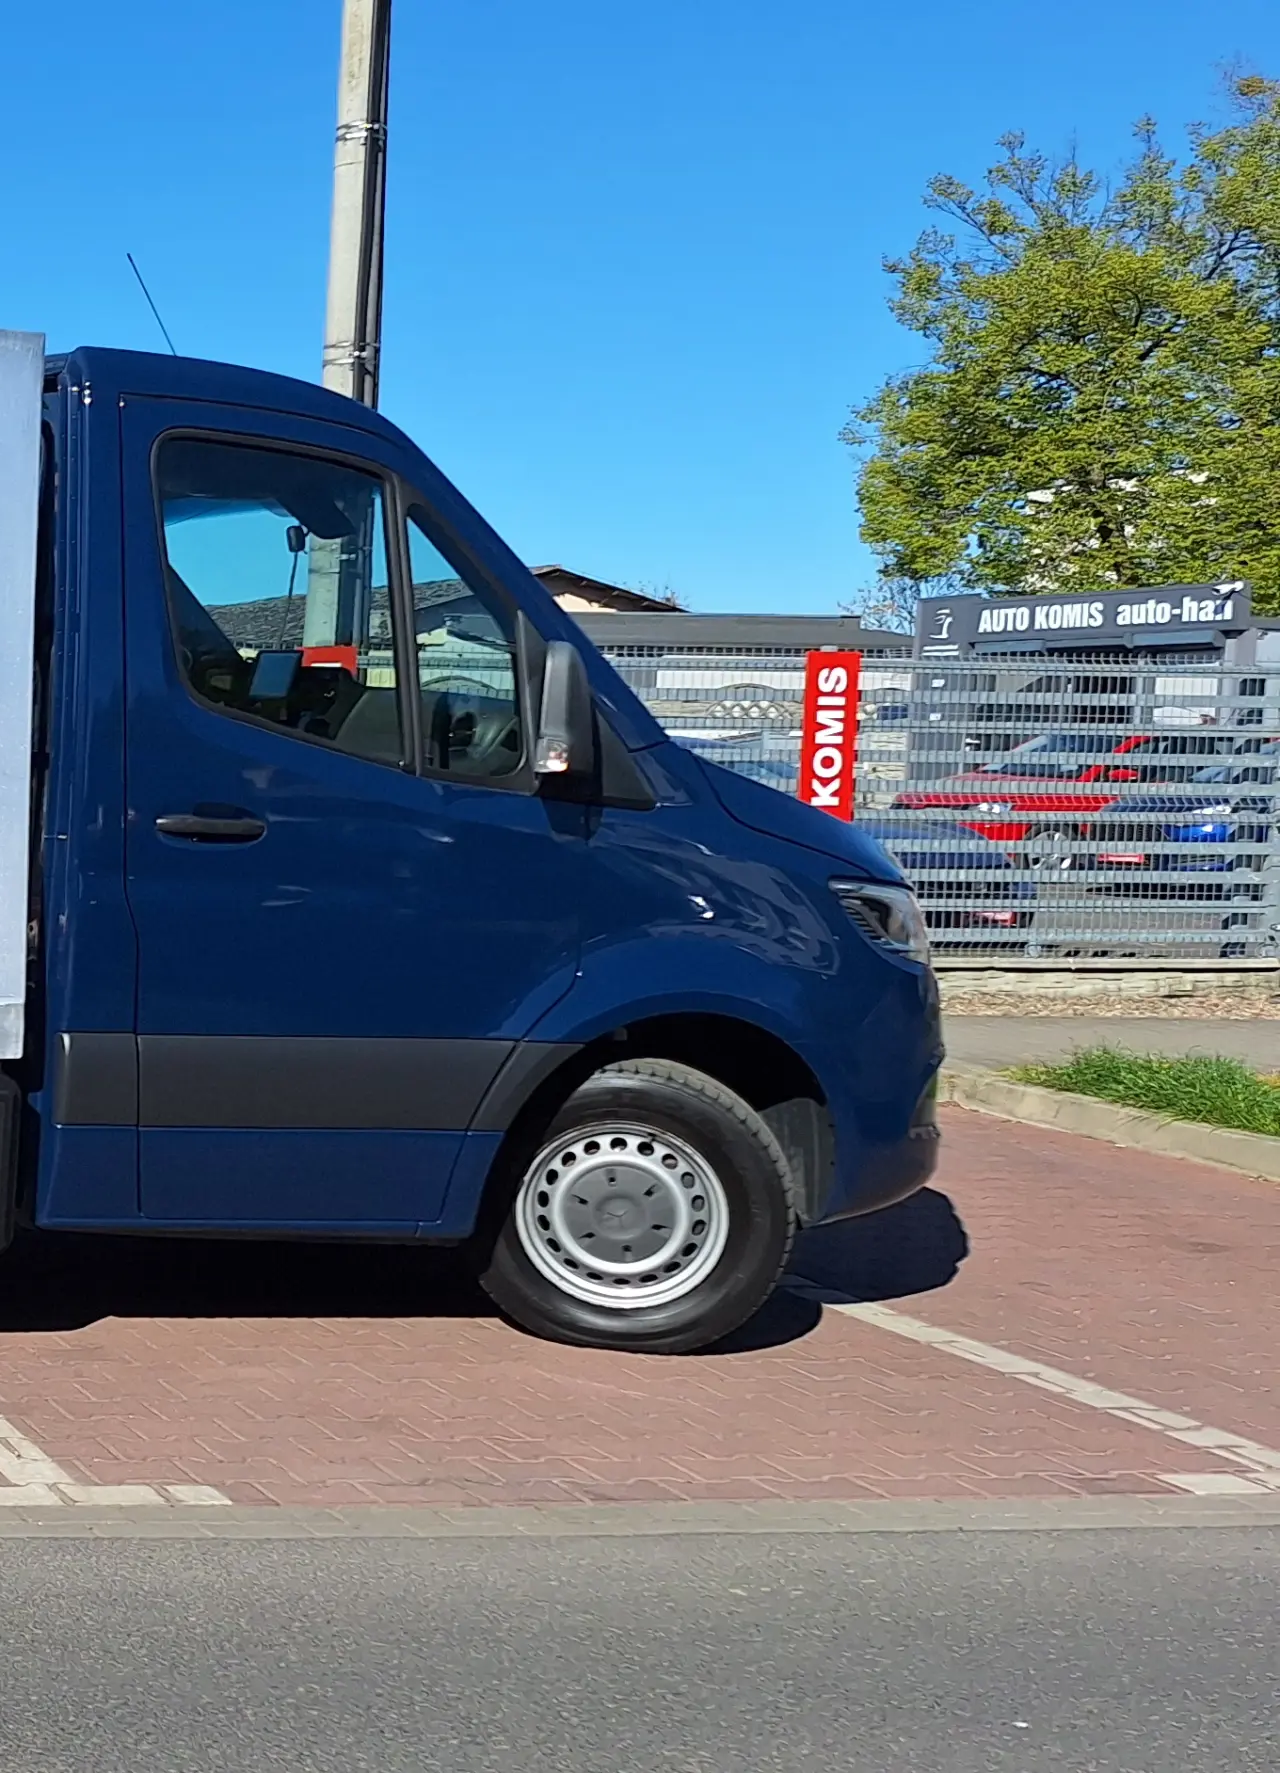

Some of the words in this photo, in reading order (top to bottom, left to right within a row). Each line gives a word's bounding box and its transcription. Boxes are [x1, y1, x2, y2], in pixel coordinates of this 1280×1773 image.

[977, 607, 1029, 633] AUTO
[1033, 602, 1104, 630] KOMIS
[809, 666, 848, 807] KOMIS
